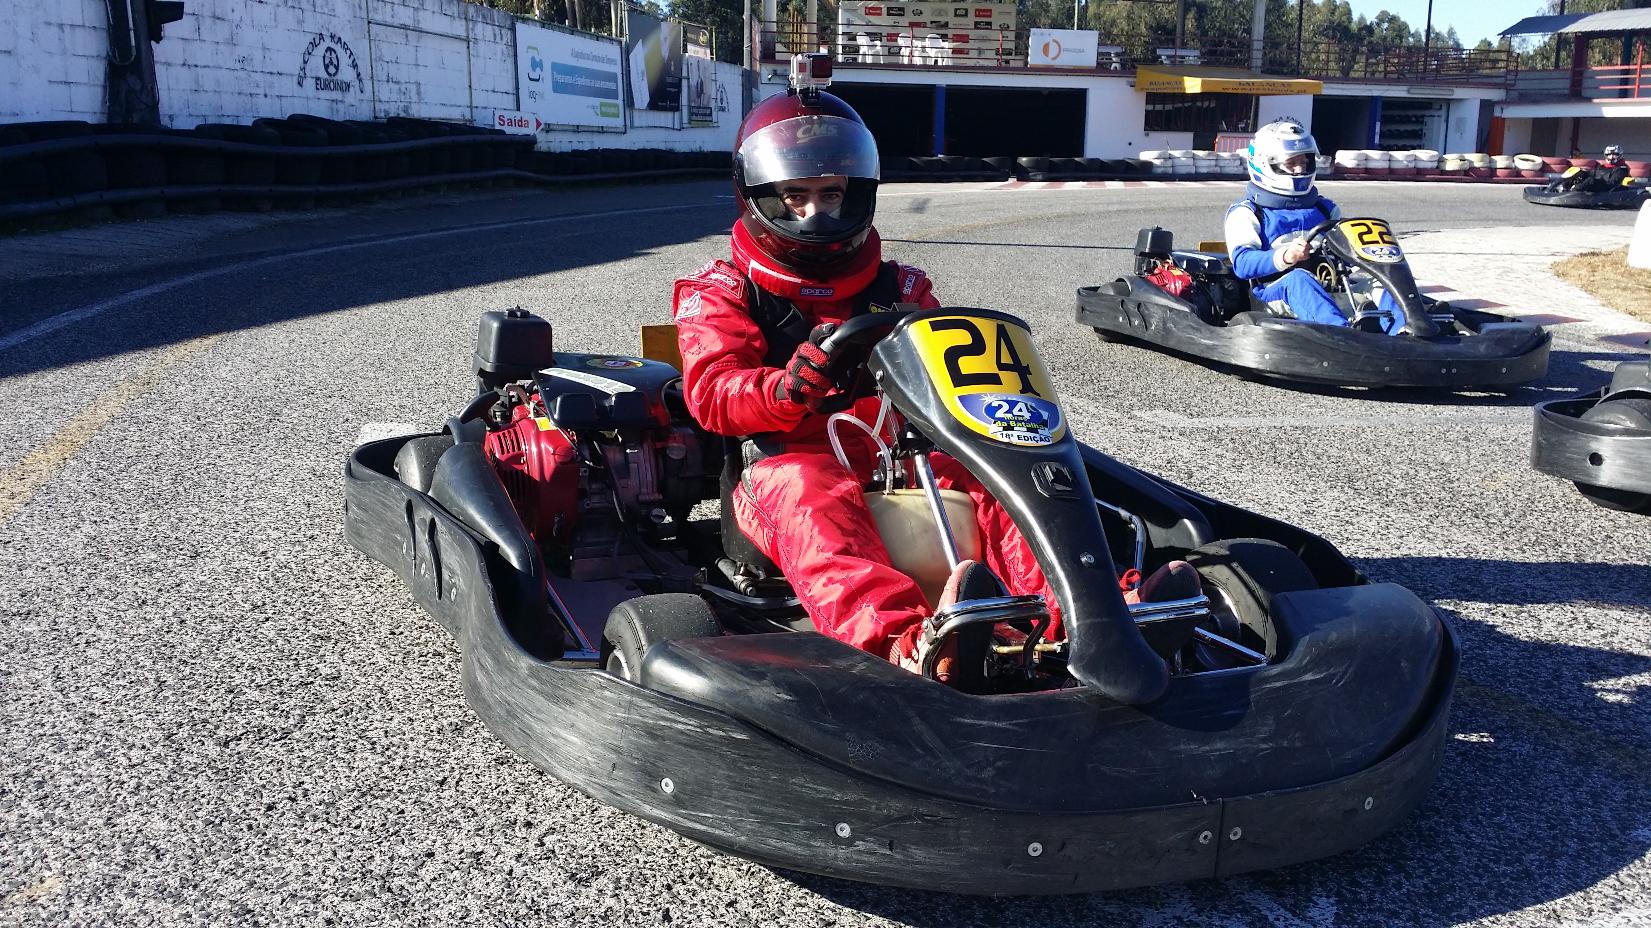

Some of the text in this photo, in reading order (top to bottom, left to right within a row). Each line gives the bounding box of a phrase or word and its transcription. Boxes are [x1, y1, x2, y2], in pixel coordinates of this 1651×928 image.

[297, 32, 364, 94] ESCOLA KARTING
[315, 77, 351, 93] EUROINDY
[498, 114, 530, 128] Saída
[796, 124, 838, 138] CMS
[1351, 222, 1399, 246] 22
[801, 287, 834, 296] sparco
[929, 318, 1041, 397] 24
[992, 400, 1031, 419] 24
[1010, 421, 1046, 431] Batalha
[1017, 433, 1052, 444] EDIÇÃO
